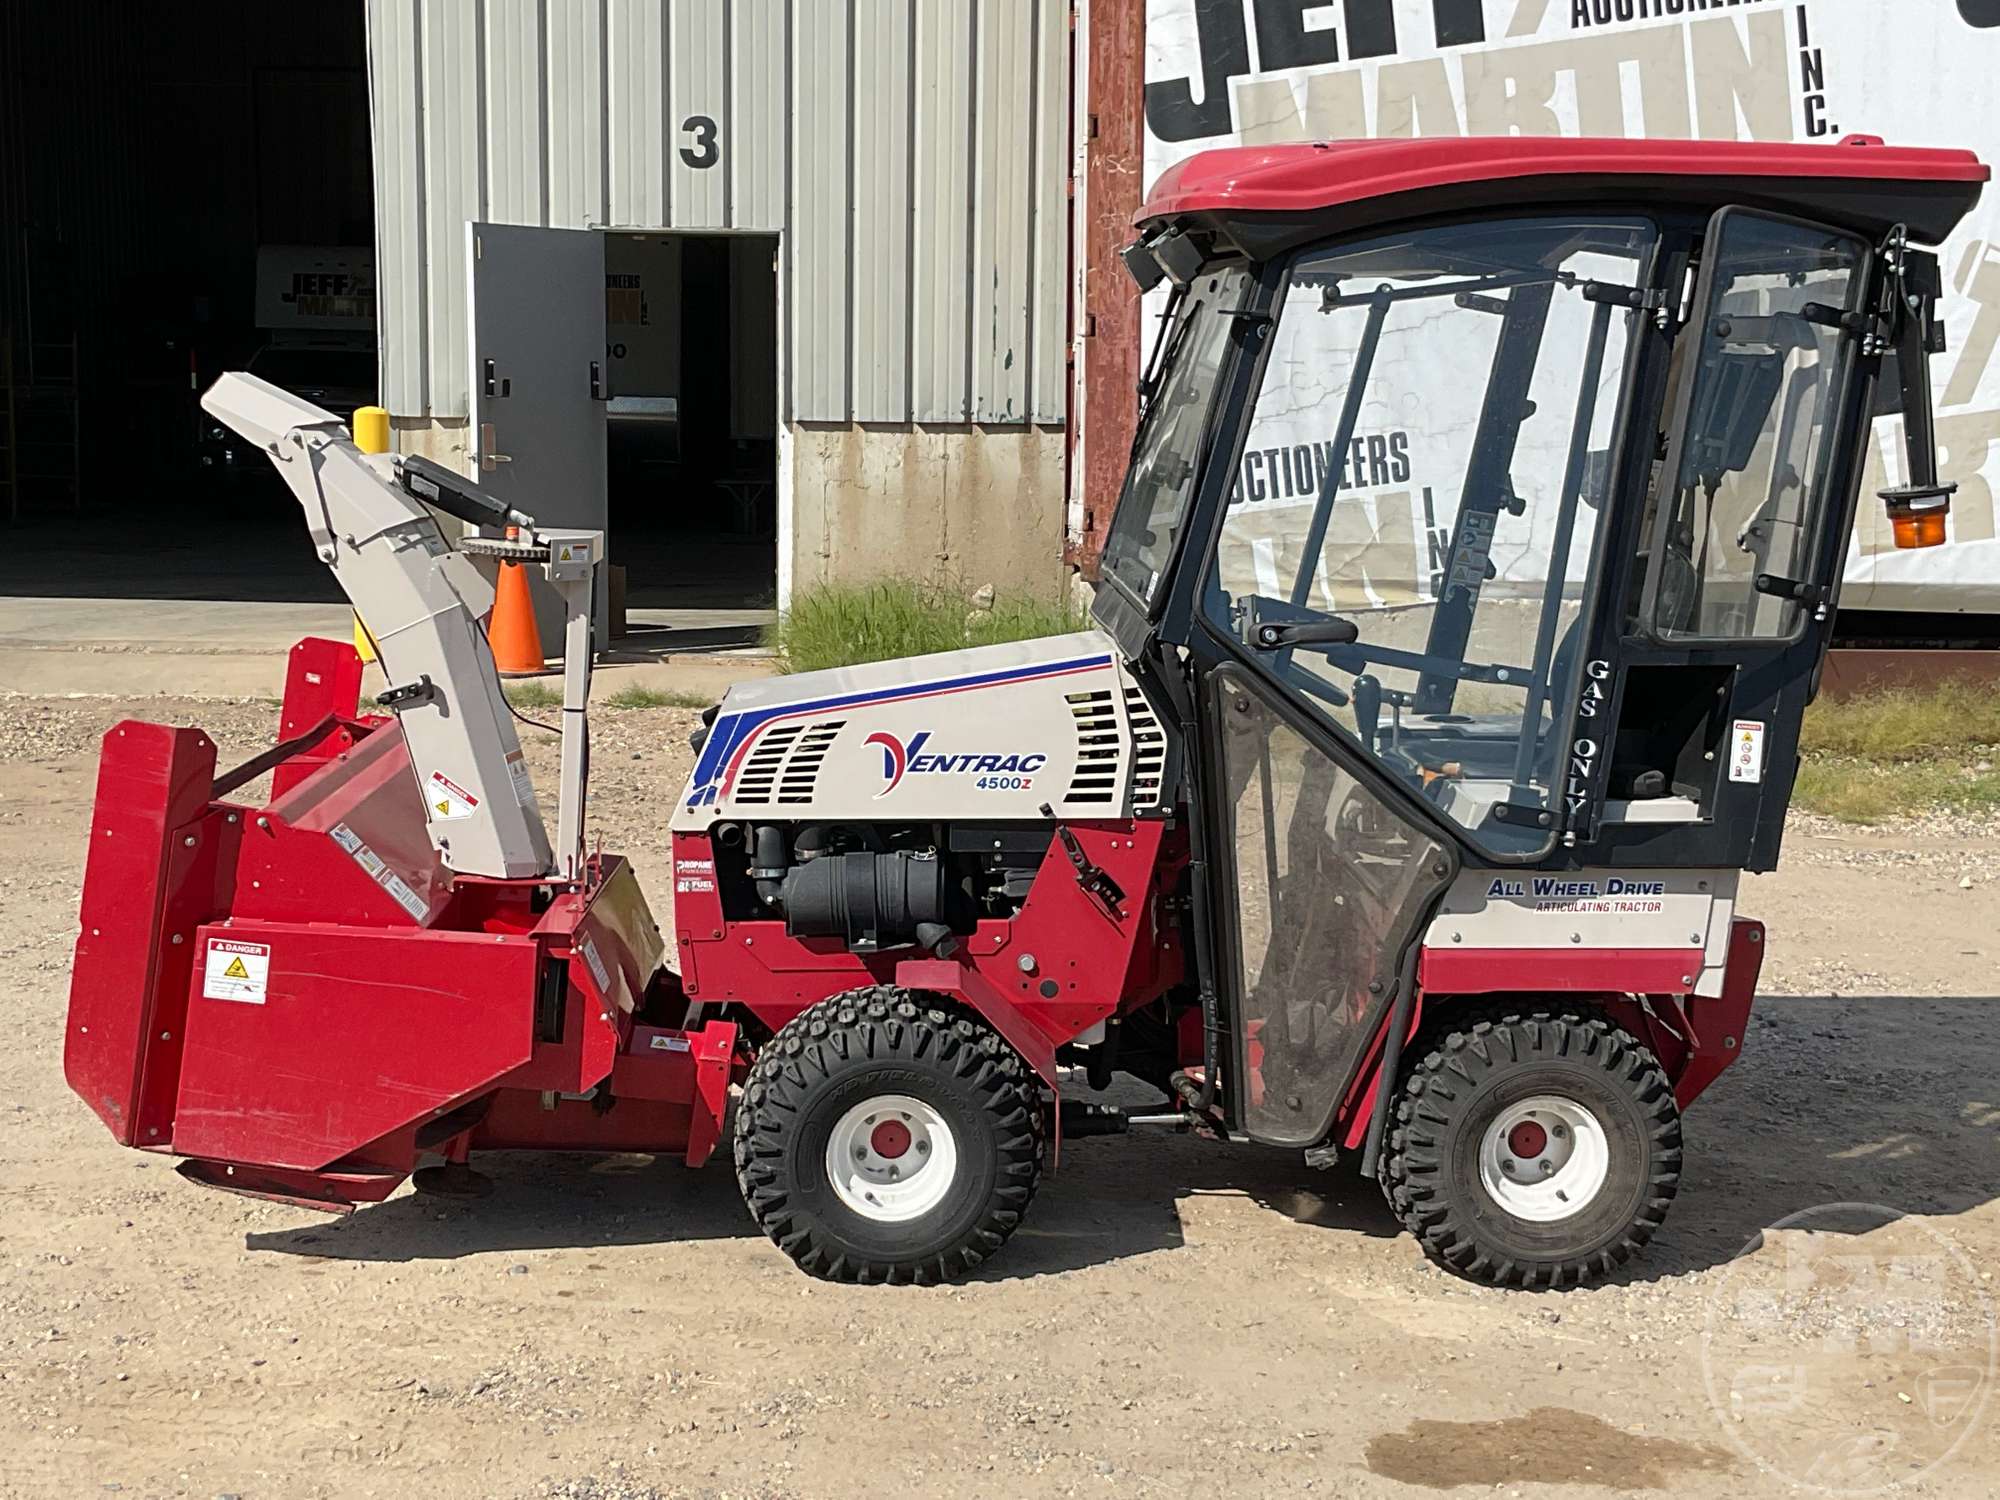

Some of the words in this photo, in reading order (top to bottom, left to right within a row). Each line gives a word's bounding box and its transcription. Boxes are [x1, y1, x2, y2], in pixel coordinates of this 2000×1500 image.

[679, 115, 720, 169] 3
[281, 273, 348, 302] JEFF
[1579, 659, 1609, 717] GAS
[864, 732, 1047, 792] VENTRAC
[1566, 738, 1597, 815] ONLY
[1488, 878, 1524, 896] ALL
[1533, 879, 1599, 896] WHEEL
[1606, 878, 1664, 896] DRIVE
[1536, 901, 1611, 913] ARTICULATING
[1615, 901, 1662, 912] TRACTOR
[225, 943, 262, 955] DANGER
